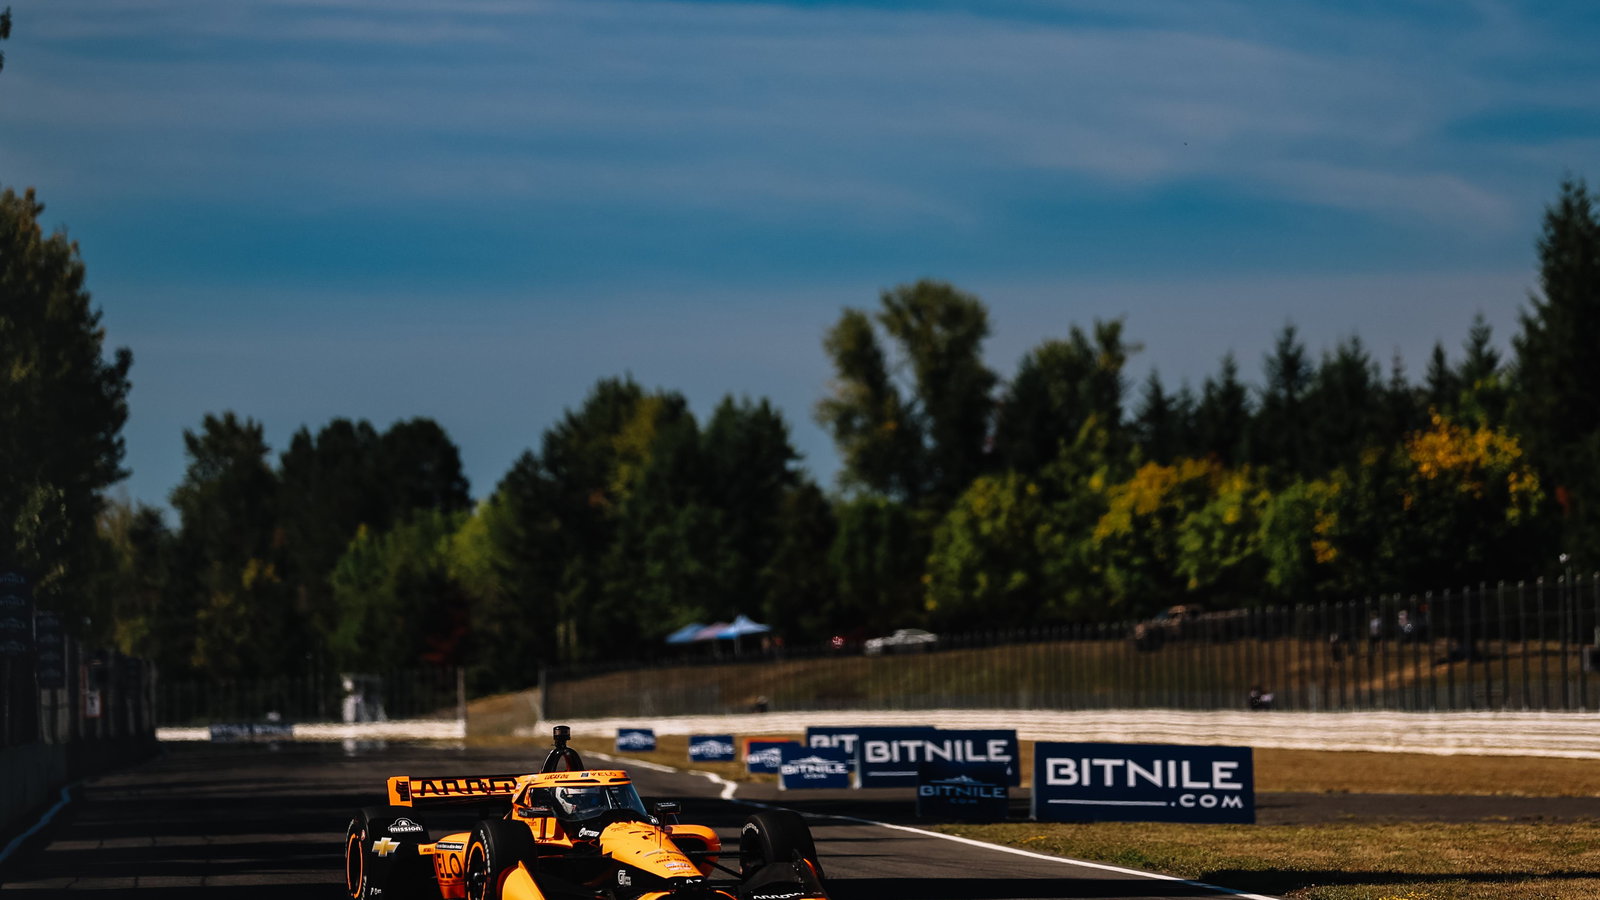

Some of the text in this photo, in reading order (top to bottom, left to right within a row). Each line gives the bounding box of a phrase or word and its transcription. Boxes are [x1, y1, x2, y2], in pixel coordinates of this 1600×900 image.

[864, 739, 1012, 763] BITNILE
[1046, 757, 1244, 790] BITNILE
[919, 785, 1007, 798] BITNILE
[1170, 793, 1244, 809] .COM
